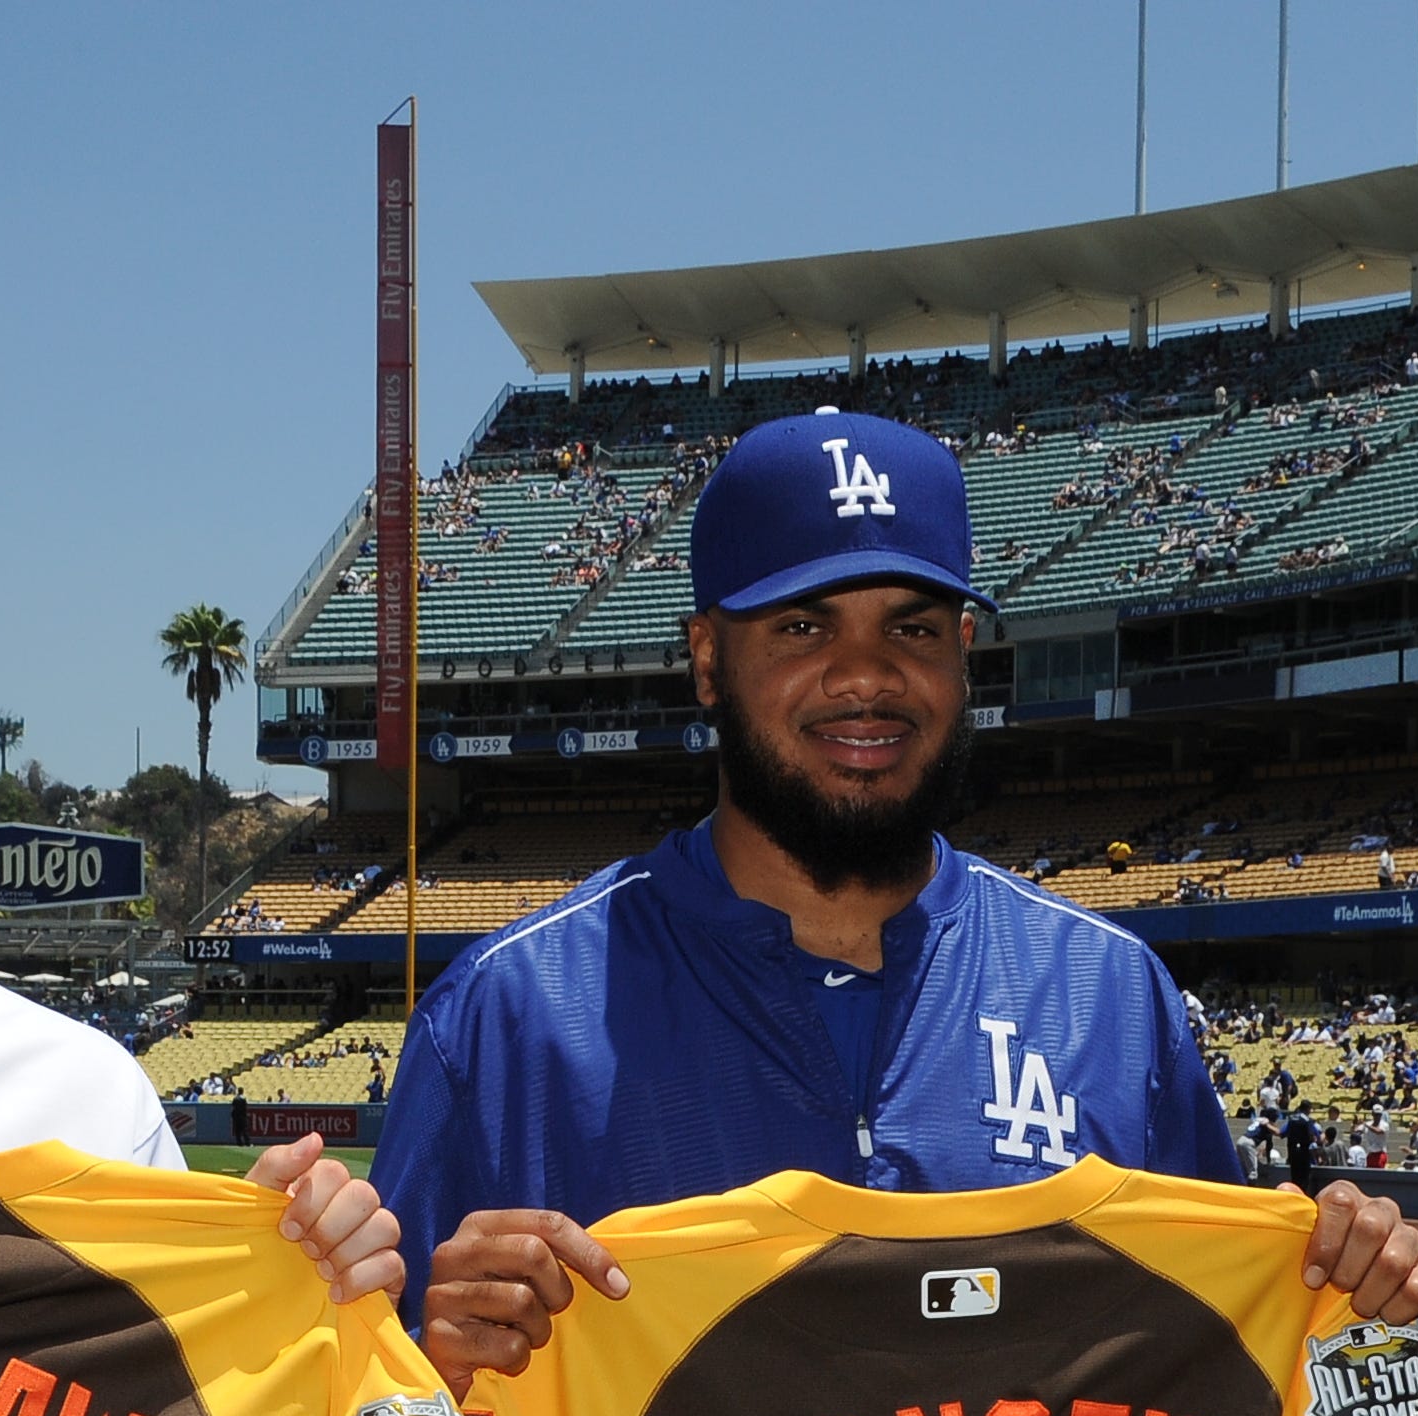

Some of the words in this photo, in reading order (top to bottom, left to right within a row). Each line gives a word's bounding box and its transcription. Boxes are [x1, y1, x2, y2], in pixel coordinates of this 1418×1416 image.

[382, 178, 402, 278] Emirates
[382, 282, 405, 320] Fly
[382, 374, 402, 469] Emirates
[382, 477, 405, 517] Fly
[822, 438, 896, 518] LA
[382, 570, 402, 668] Emirates
[382, 674, 405, 713] Fly
[336, 744, 372, 757] 1955
[464, 739, 501, 753] 1959
[592, 734, 627, 748] 1963
[188, 940, 231, 958] 12:52
[978, 1016, 1077, 1167] LA
[248, 1112, 270, 1134] ly
[275, 1110, 351, 1132] Emirates
[1312, 1364, 1368, 1416] ALL
